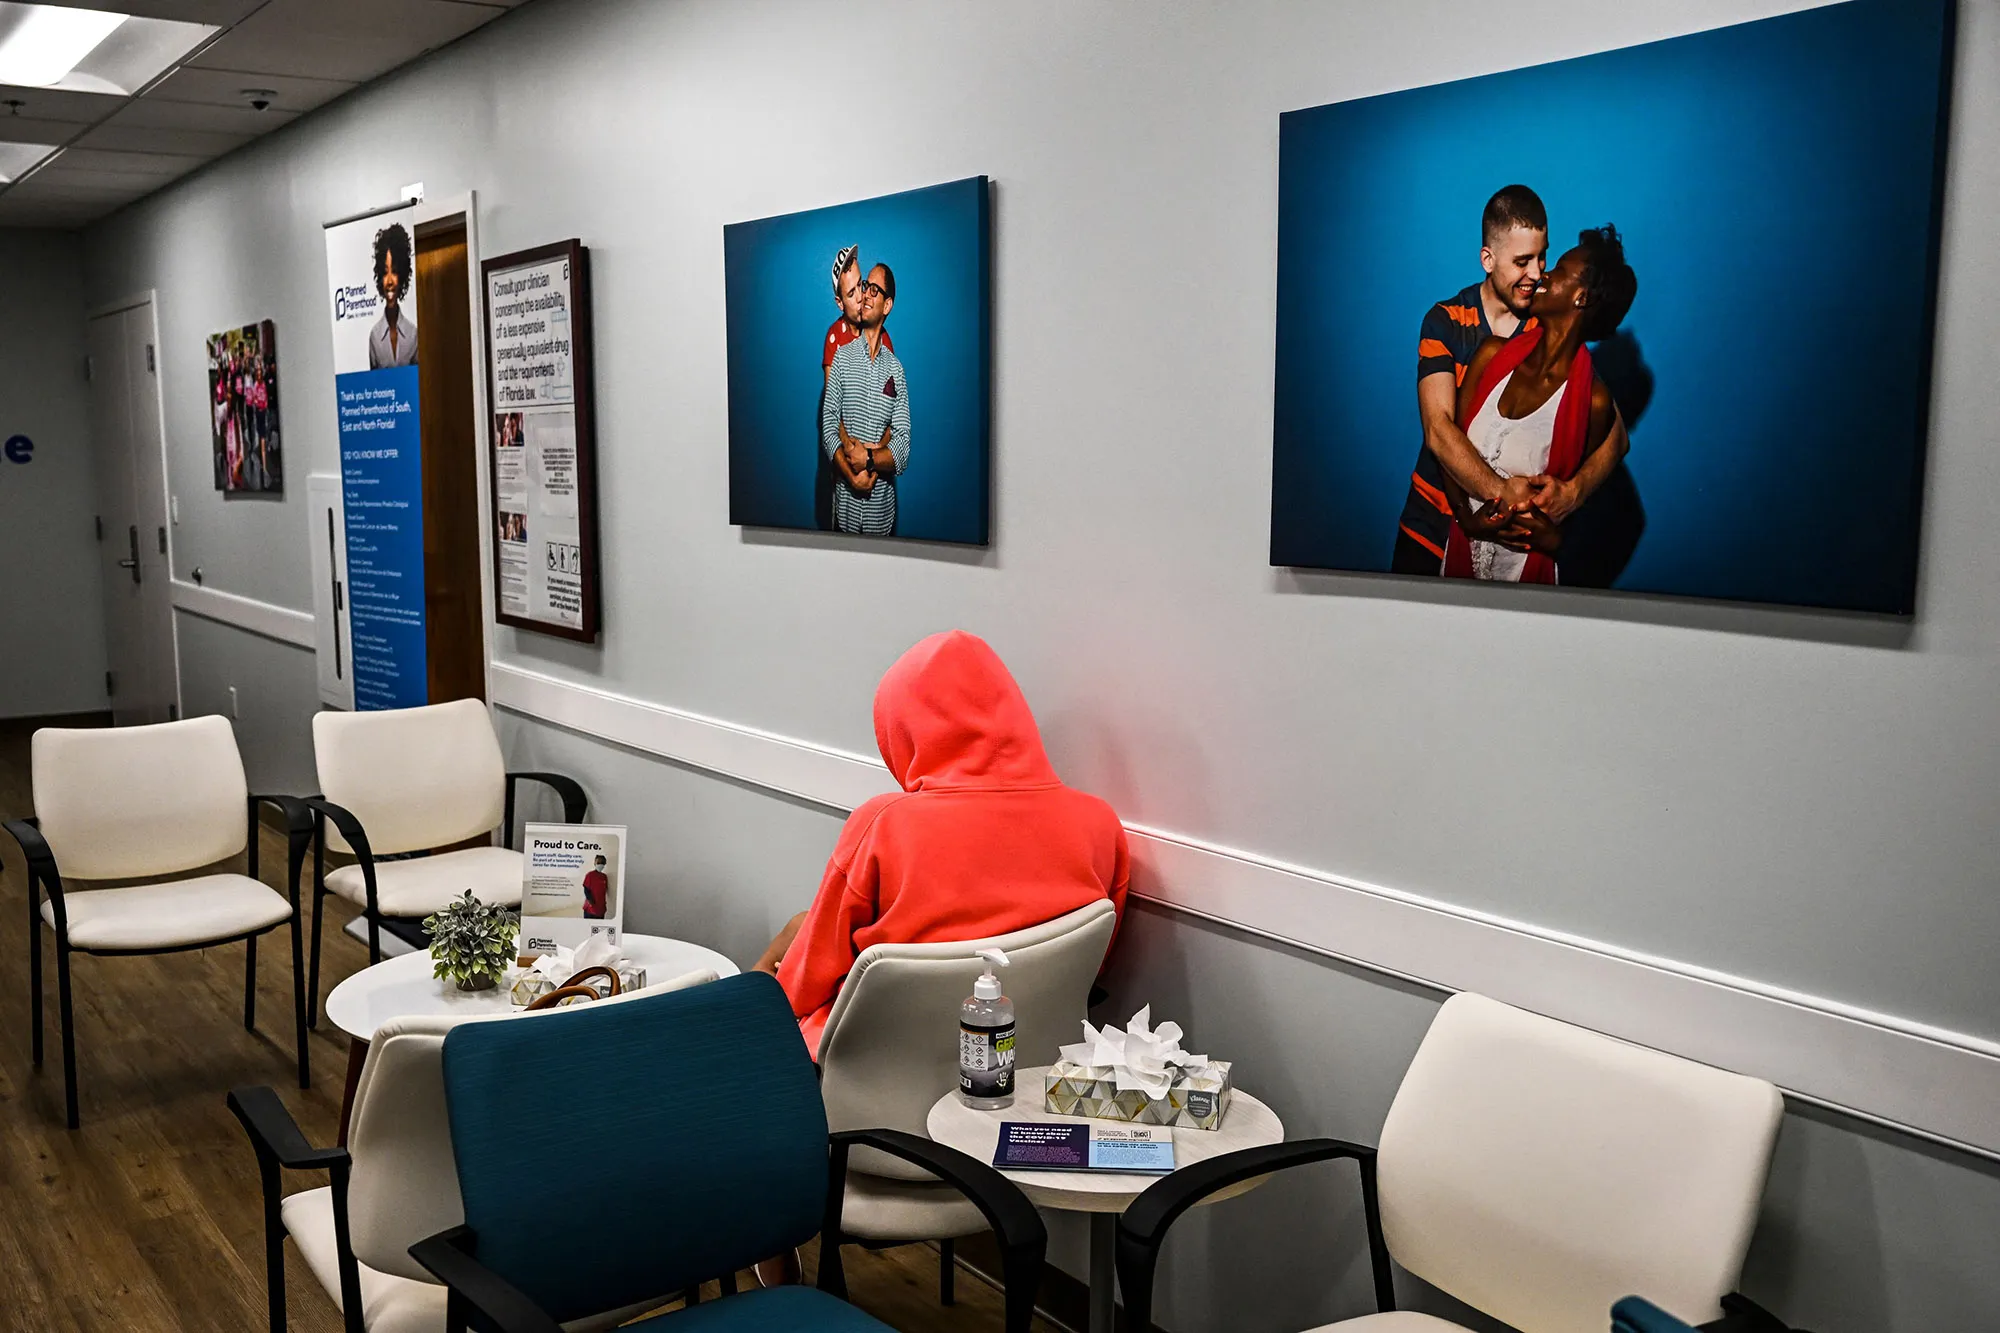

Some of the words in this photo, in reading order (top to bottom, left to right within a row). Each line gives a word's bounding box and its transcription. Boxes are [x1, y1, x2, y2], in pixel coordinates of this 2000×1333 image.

[345, 283, 367, 297] Planned
[494, 278, 514, 297] Consult
[514, 280, 526, 297] your
[527, 272, 550, 290] clinician
[346, 295, 377, 310] Parenthood
[495, 299, 524, 318] concerning
[525, 297, 534, 312] the
[535, 291, 565, 311] availability
[496, 323, 502, 339] of
[503, 327, 507, 338] a
[507, 322, 518, 338] less
[519, 318, 545, 339] expensive
[497, 342, 526, 364] generically
[527, 340, 554, 360] equivalent
[555, 336, 569, 356] drug
[498, 365, 508, 381] and
[509, 365, 518, 380] the
[519, 362, 555, 382] requirements
[340, 390, 355, 401] Thank
[356, 392, 365, 403] you
[364, 388, 372, 399] for
[373, 388, 396, 401] choosing
[499, 386, 505, 402] of
[506, 386, 524, 401] Florida
[525, 385, 537, 400] law.
[341, 404, 360, 416] Planned
[360, 402, 389, 415] Parenthood
[389, 401, 395, 413] of
[342, 421, 352, 432] East
[353, 420, 362, 431] and
[362, 419, 376, 431] North
[534, 839, 562, 849] Proud
[564, 841, 575, 850] to
[576, 841, 602, 850] Care.
[996, 1036, 1015, 1052] GER
[996, 1047, 1015, 1066] WA
